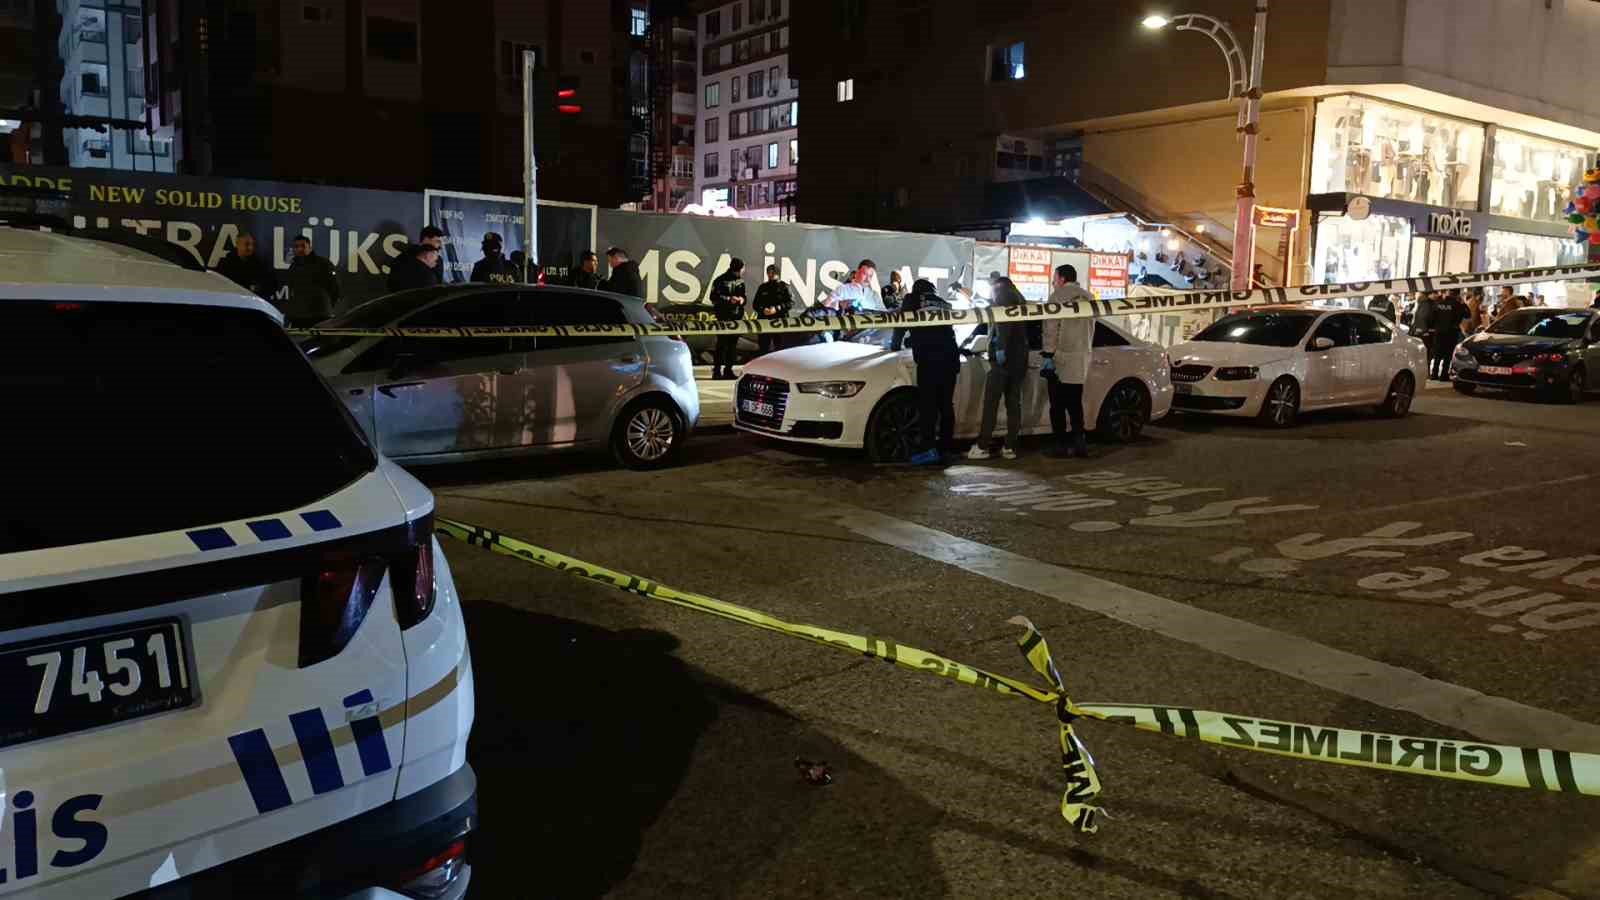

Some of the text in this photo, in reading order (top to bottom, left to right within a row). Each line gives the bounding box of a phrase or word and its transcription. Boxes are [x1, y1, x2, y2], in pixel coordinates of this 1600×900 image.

[89, 184, 303, 213] NEW SOLID HOUSE
[27, 632, 172, 714] 7451
